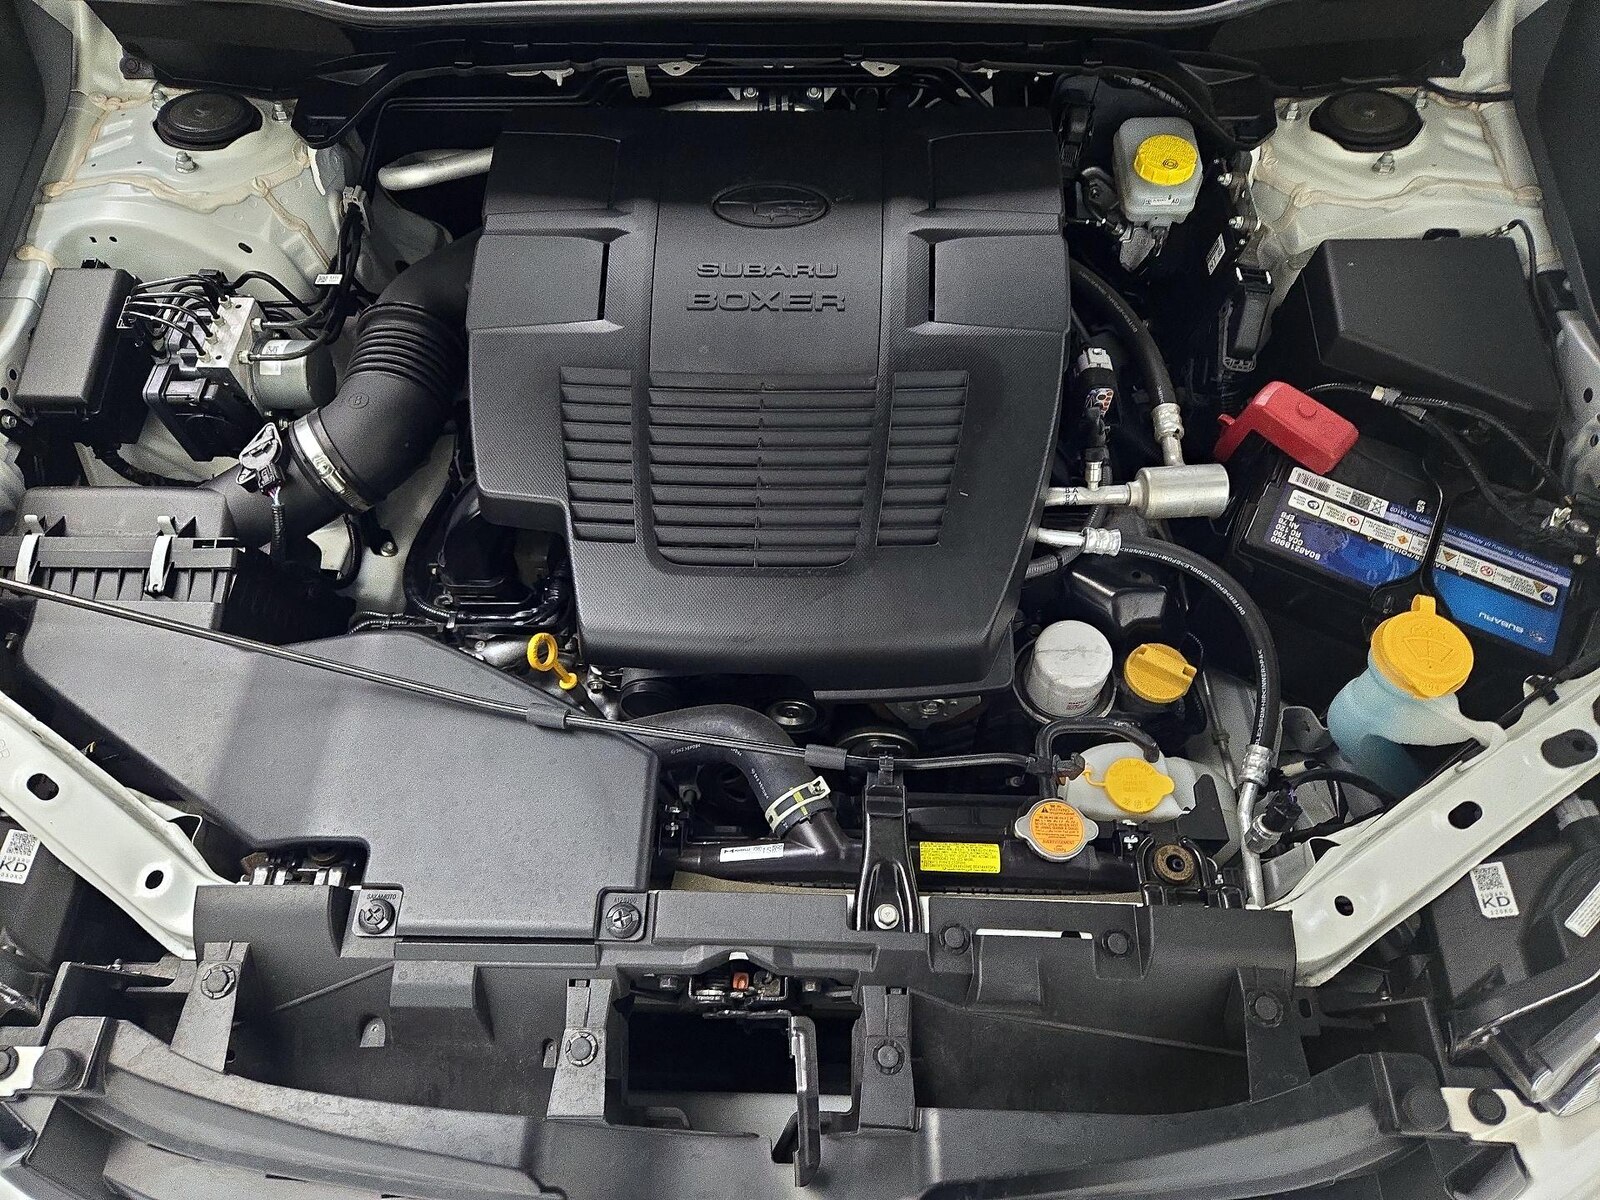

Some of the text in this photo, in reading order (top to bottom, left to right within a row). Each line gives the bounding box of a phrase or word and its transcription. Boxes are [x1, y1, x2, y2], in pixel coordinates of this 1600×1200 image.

[696, 262, 838, 278] SUBARU
[686, 290, 845, 312] BOXER
[1477, 611, 1524, 633] SUBARU
[0, 860, 27, 872] KD
[1482, 896, 1510, 908] KD
